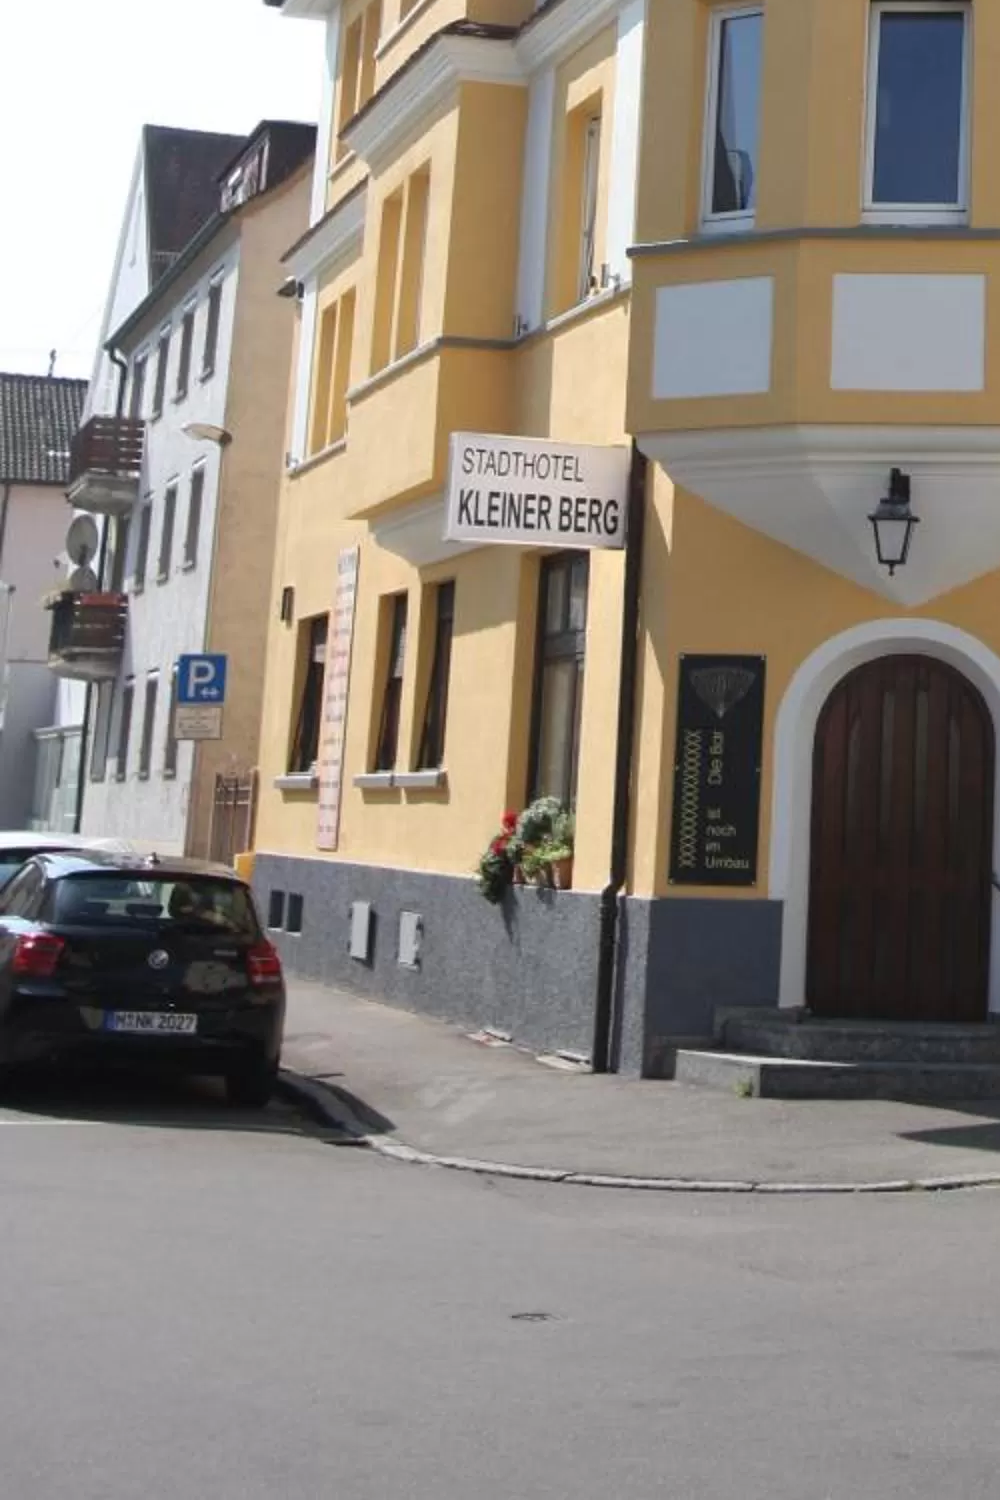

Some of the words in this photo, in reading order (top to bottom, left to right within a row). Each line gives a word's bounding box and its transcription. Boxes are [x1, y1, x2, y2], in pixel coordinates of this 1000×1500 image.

[462, 447, 584, 482] STADTHOTEL
[458, 488, 552, 530] KLEINER
[558, 496, 619, 535] BERG
[187, 661, 215, 698] P
[705, 823, 737, 837] noch
[703, 855, 750, 869] Umbau
